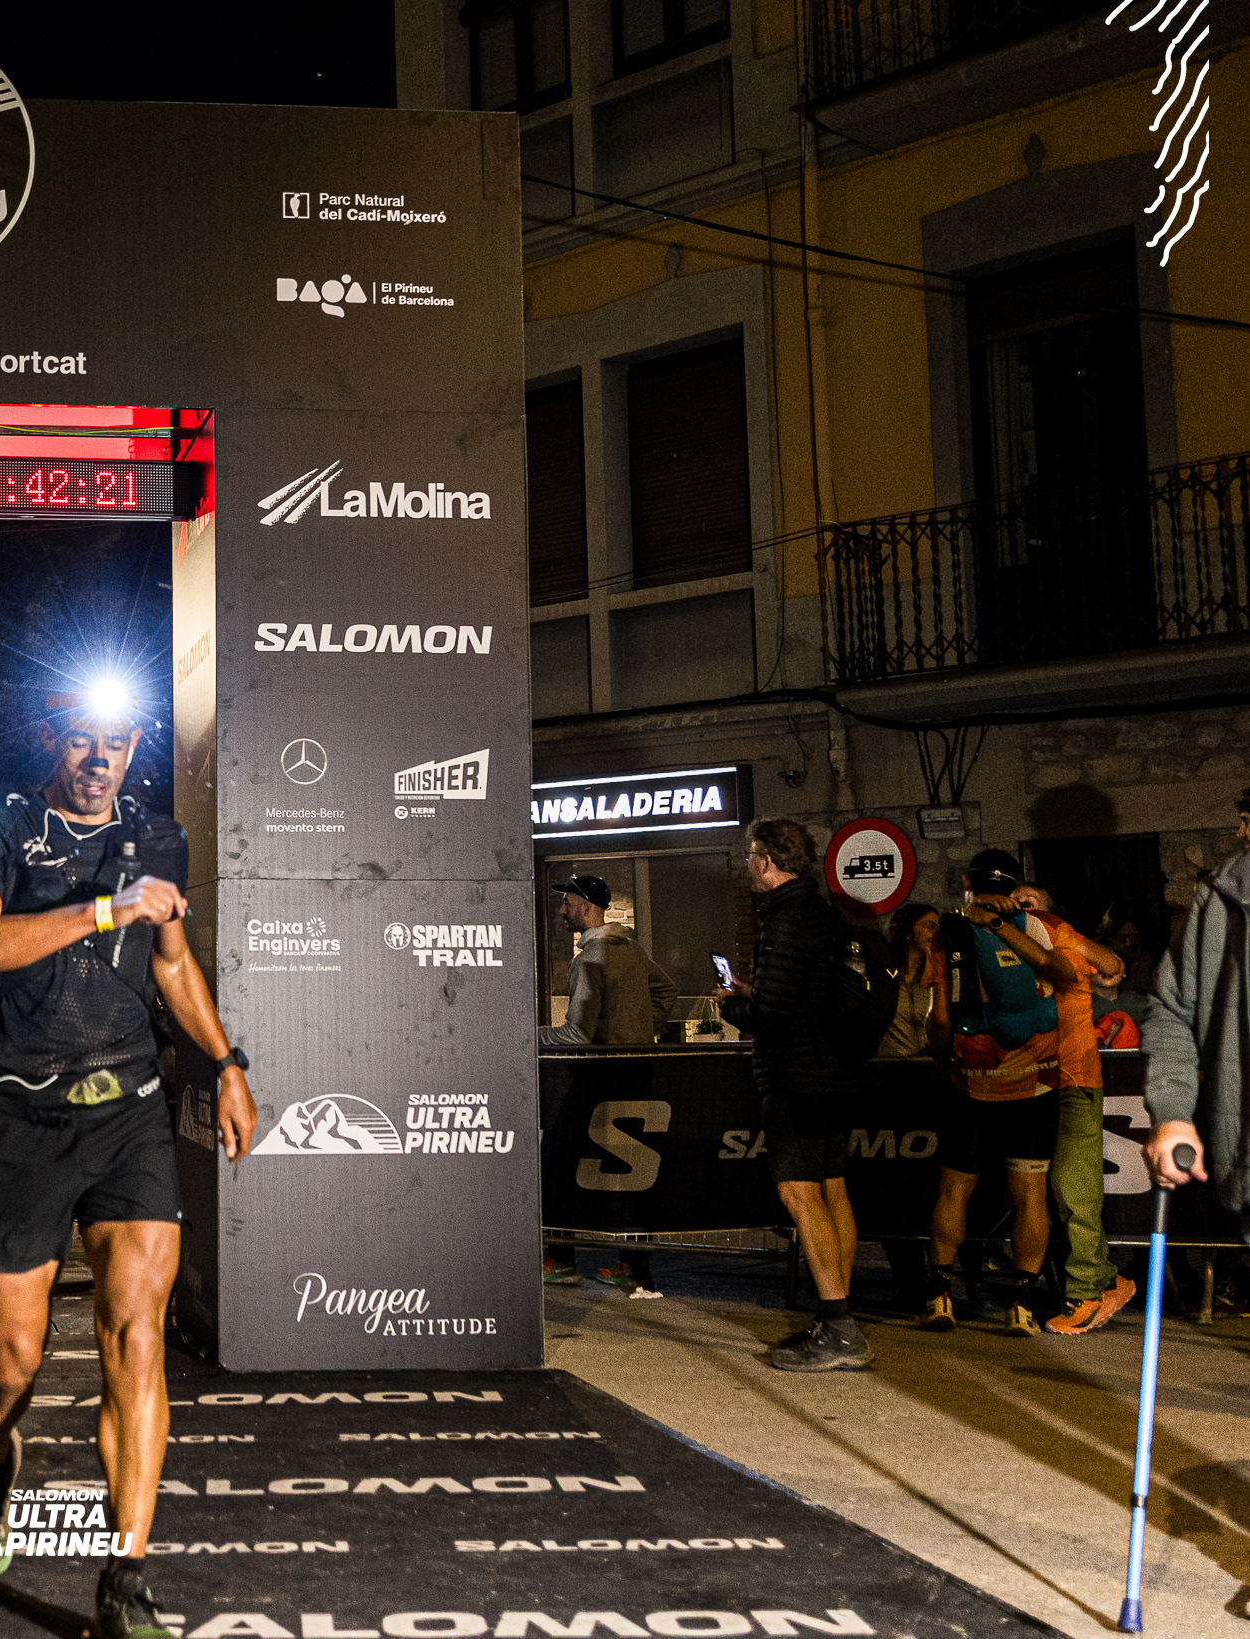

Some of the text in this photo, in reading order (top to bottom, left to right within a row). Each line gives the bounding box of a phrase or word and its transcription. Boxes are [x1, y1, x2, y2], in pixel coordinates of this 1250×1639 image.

[319, 192, 405, 207] Parc Natural
[319, 207, 447, 224] del Cadí-Moixeró
[381, 283, 434, 294] El Pirineu
[381, 295, 455, 307] de Barcelona
[254, 622, 493, 654] SALOMON
[265, 807, 345, 819] Mercedes-Benz
[315, 823, 345, 833] stern
[247, 919, 303, 935] Caixa
[413, 924, 503, 949] SPARTAN
[248, 936, 341, 956] Enginyers
[413, 949, 503, 967] TRAIL
[408, 1093, 489, 1106] SALOMON
[405, 1107, 491, 1130] ULTRA
[403, 1131, 515, 1154] PIRINEU
[293, 1272, 431, 1335] Pangea
[382, 1317, 498, 1337] ATTITUDE
[339, 1431, 602, 1442] SALOMON
[454, 1537, 786, 1552] SALOMON
